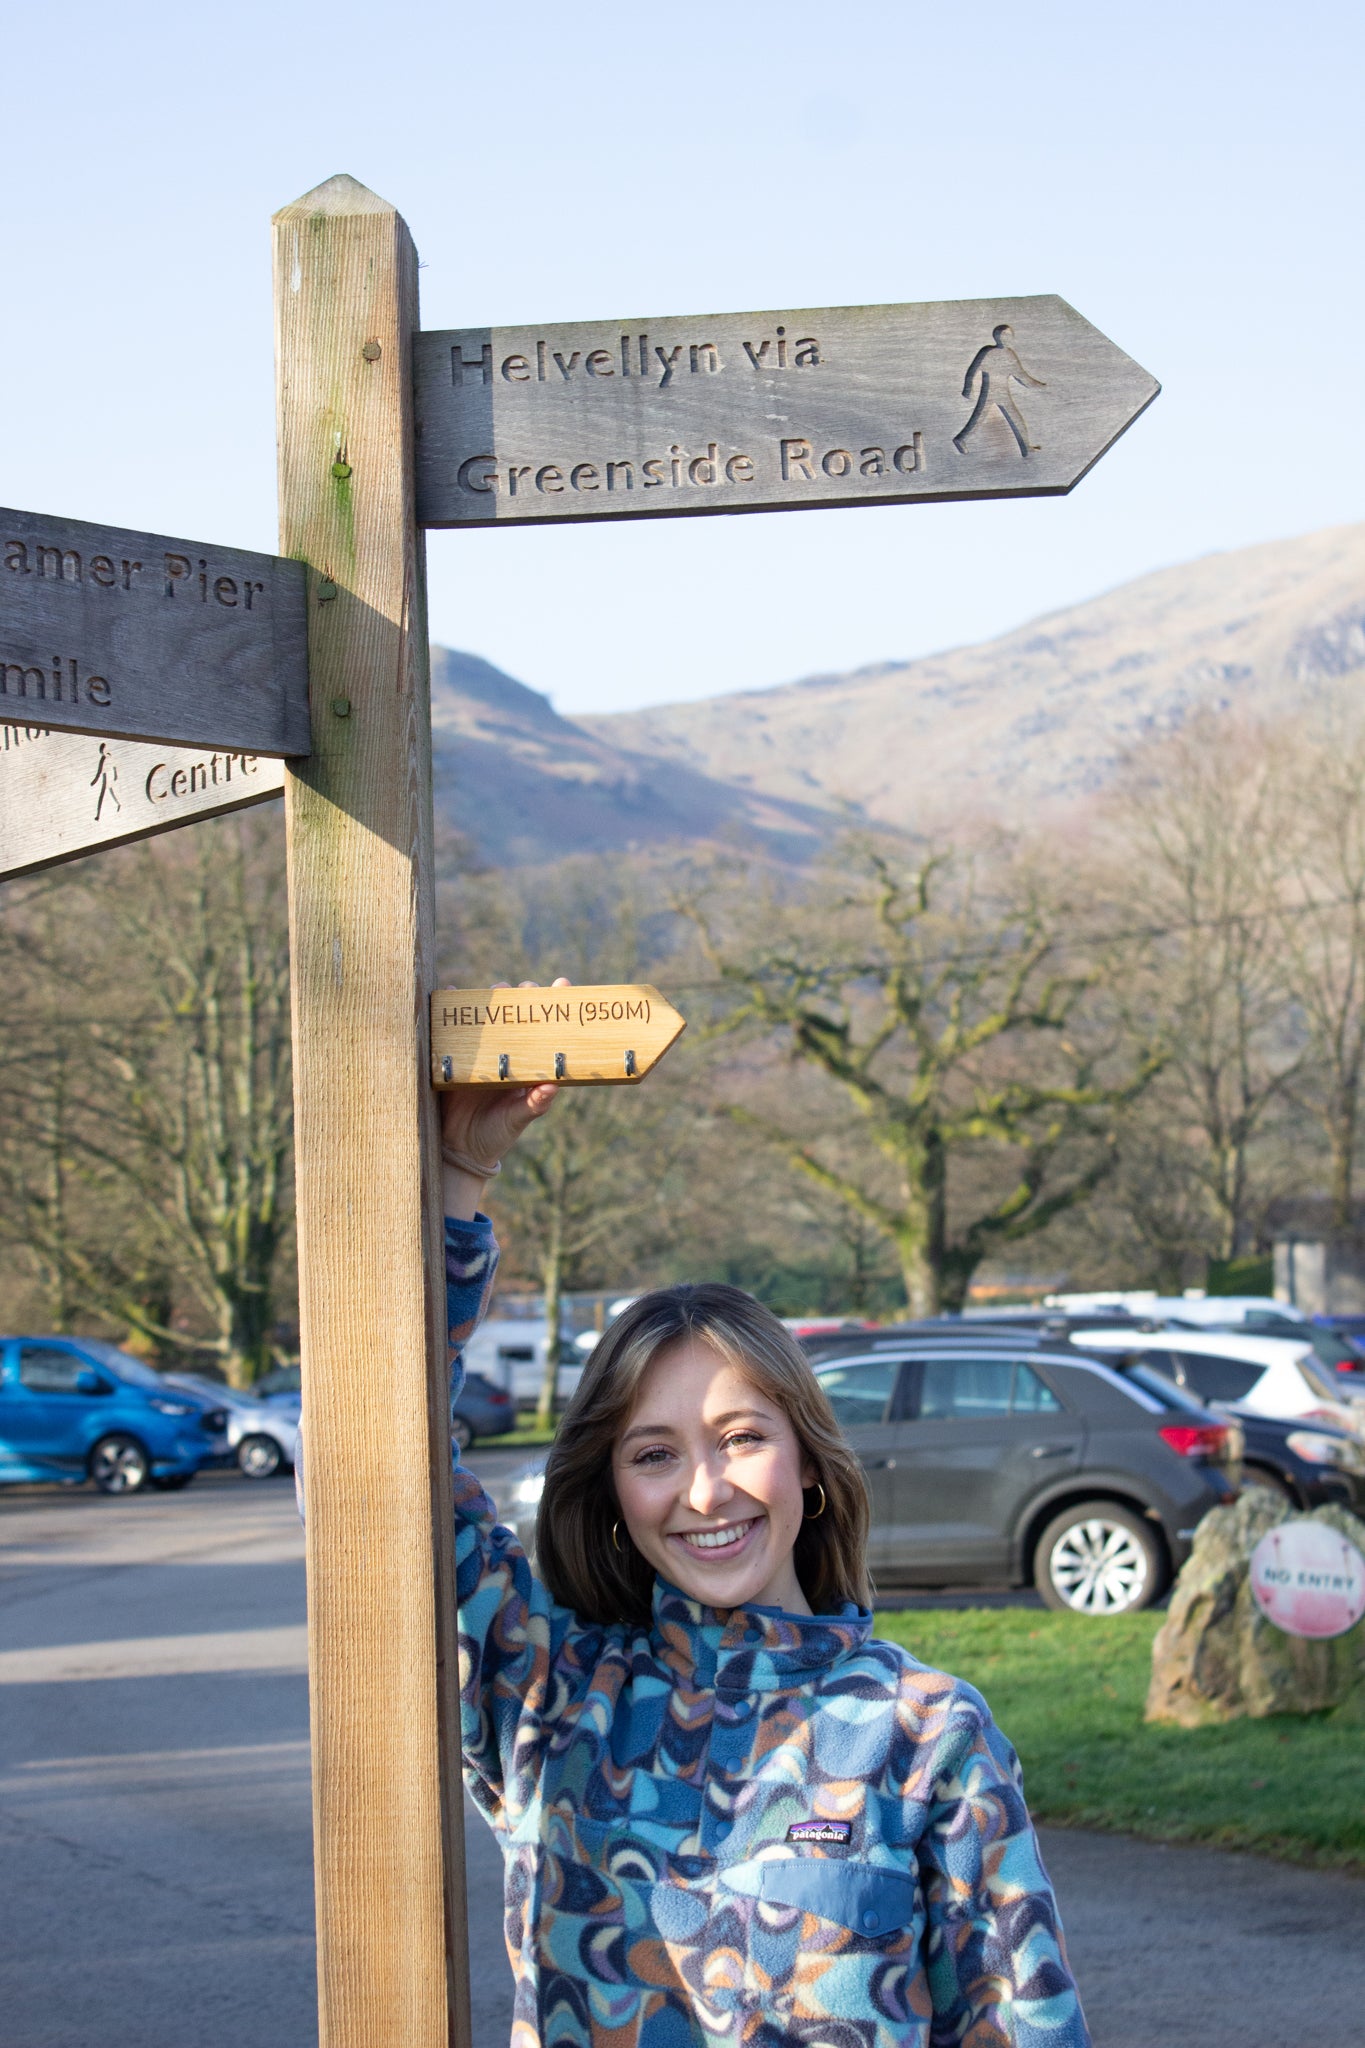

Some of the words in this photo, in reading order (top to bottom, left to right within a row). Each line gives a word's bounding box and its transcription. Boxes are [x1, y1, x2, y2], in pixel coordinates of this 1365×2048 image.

[450, 334, 720, 389] Helvellyn
[742, 326, 823, 370] via
[457, 442, 755, 497] Greenside
[780, 431, 925, 481] Road
[164, 552, 264, 611] Pier
[0, 655, 112, 707] mile
[145, 752, 258, 805] Centre
[442, 1003, 571, 1027] HELVELLYN
[579, 1000, 651, 1025] (950M)
[1265, 1568, 1290, 1583] NO
[1297, 1572, 1354, 1589] ENTRY
[793, 1831, 845, 1840] patagonia
